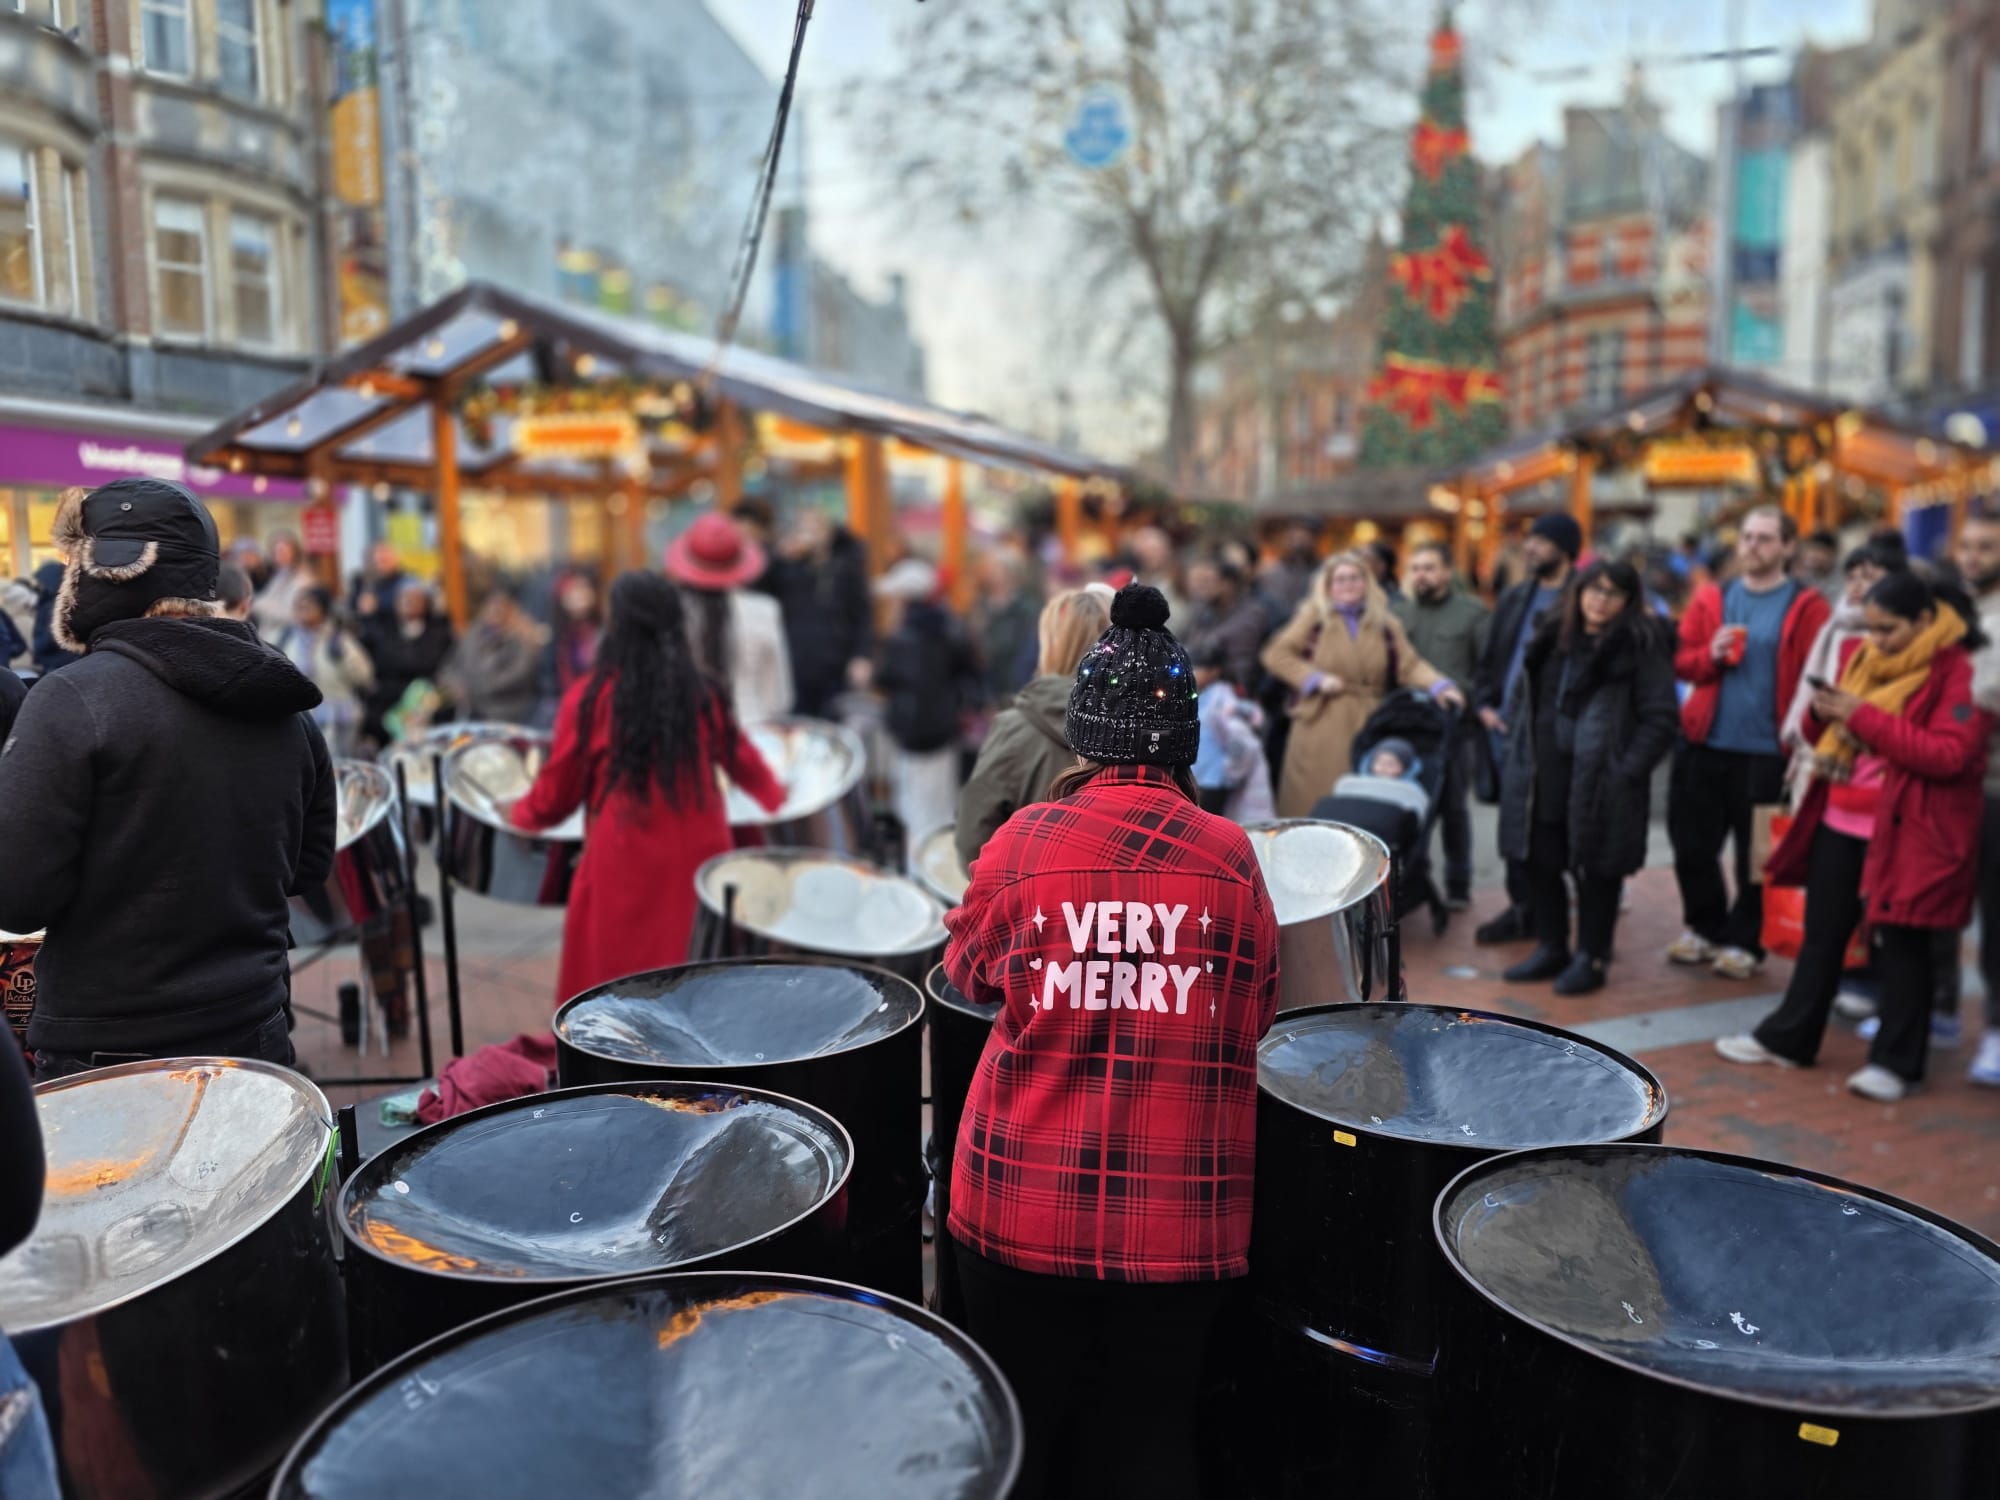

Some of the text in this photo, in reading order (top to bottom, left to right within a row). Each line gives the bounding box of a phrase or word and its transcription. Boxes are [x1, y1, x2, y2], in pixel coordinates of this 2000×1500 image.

[1061, 901, 1189, 955] VERY
[15, 974, 34, 991] LP
[1042, 960, 1201, 1015] MERRY
[569, 1211, 584, 1224] C
